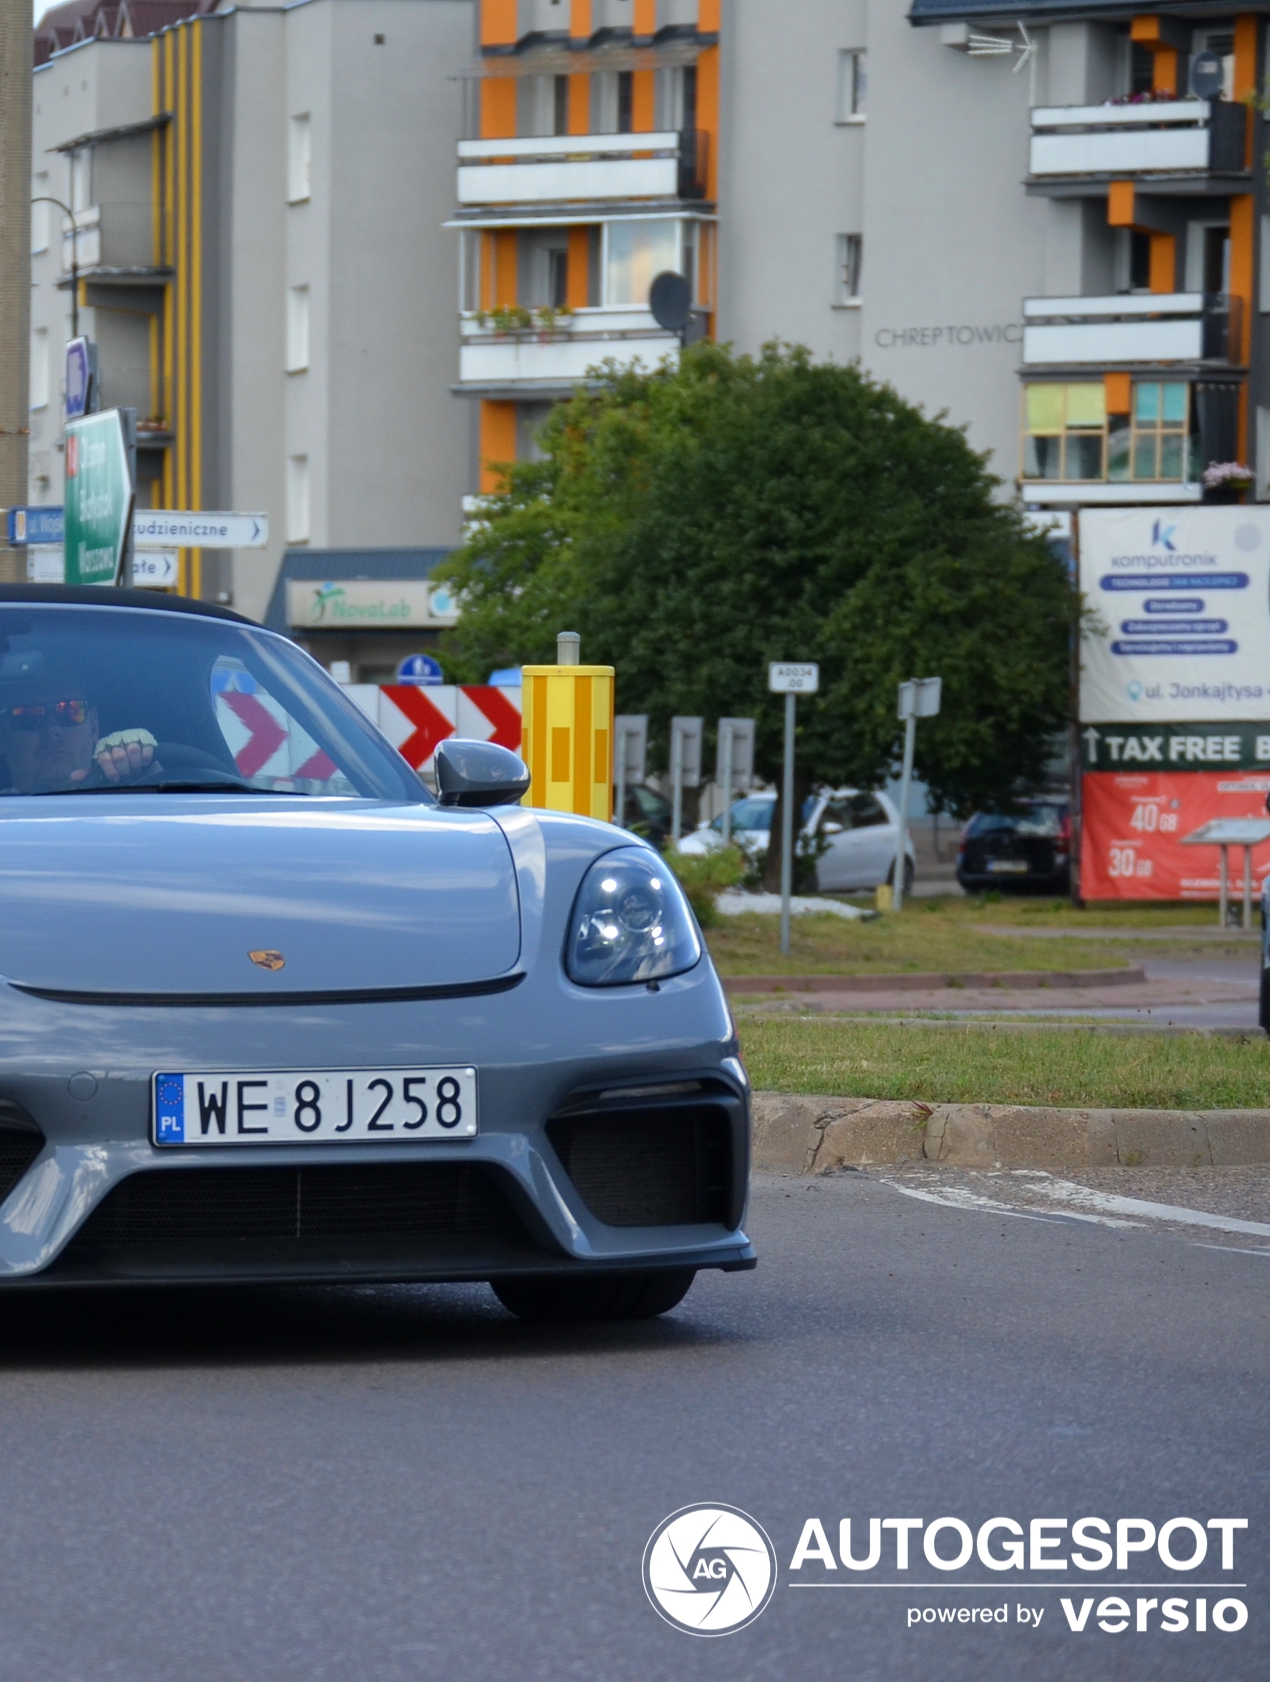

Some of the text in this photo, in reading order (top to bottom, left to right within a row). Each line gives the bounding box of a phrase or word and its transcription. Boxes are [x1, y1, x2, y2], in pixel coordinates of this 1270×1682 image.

[1112, 551, 1217, 569] komputronik
[1111, 577, 1171, 587] TECHNOLOGIE
[333, 598, 412, 618] NovaLab
[1145, 681, 1263, 700] ul. Jonkajtysa
[1105, 736, 1163, 761] TAX
[1169, 735, 1242, 761] FREE
[1130, 804, 1178, 832] 40 GB
[1108, 847, 1135, 877] 30
[197, 1075, 462, 1135] WE 8J258
[161, 1116, 181, 1132] PL
